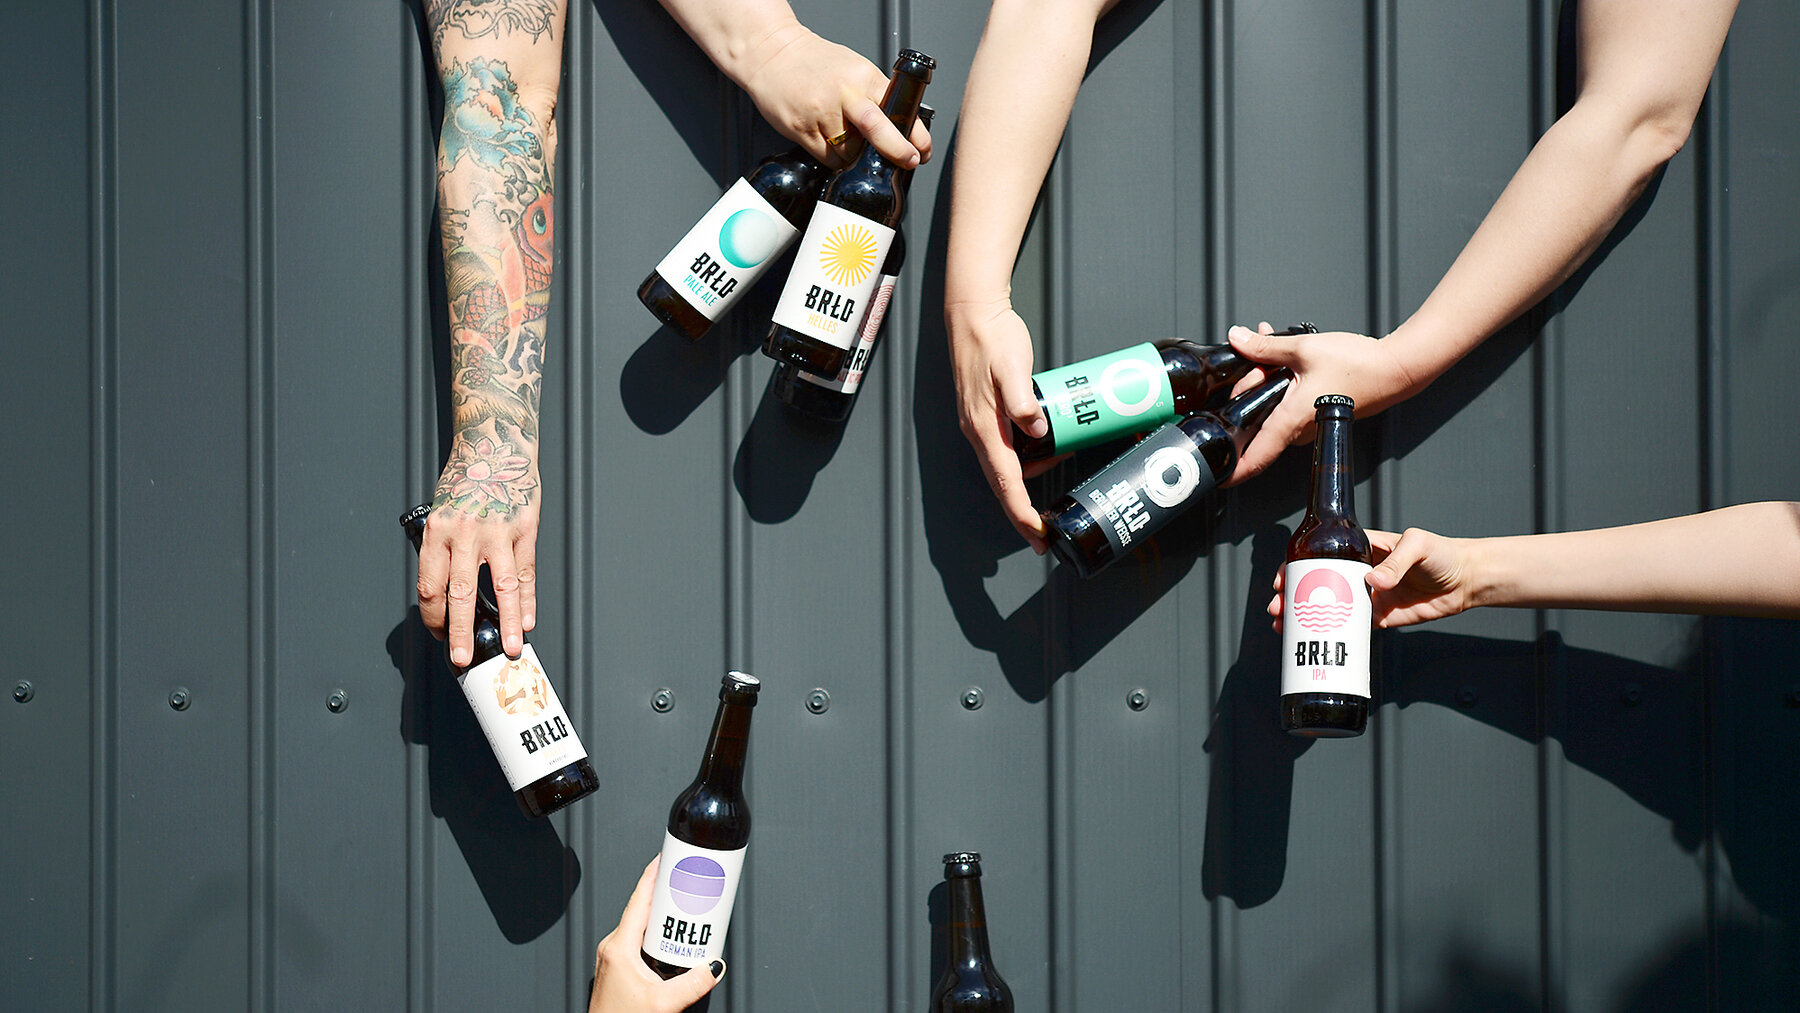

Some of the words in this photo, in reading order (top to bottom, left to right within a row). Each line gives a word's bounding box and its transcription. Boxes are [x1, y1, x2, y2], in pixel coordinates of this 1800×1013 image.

[683, 274, 703, 296] PALE
[700, 288, 719, 307] ALE
[807, 313, 839, 334] HELLES
[1113, 518, 1132, 547] WEISSE
[1312, 669, 1327, 680] IPA
[660, 940, 692, 957] GERMAN
[694, 947, 706, 958] IPA
